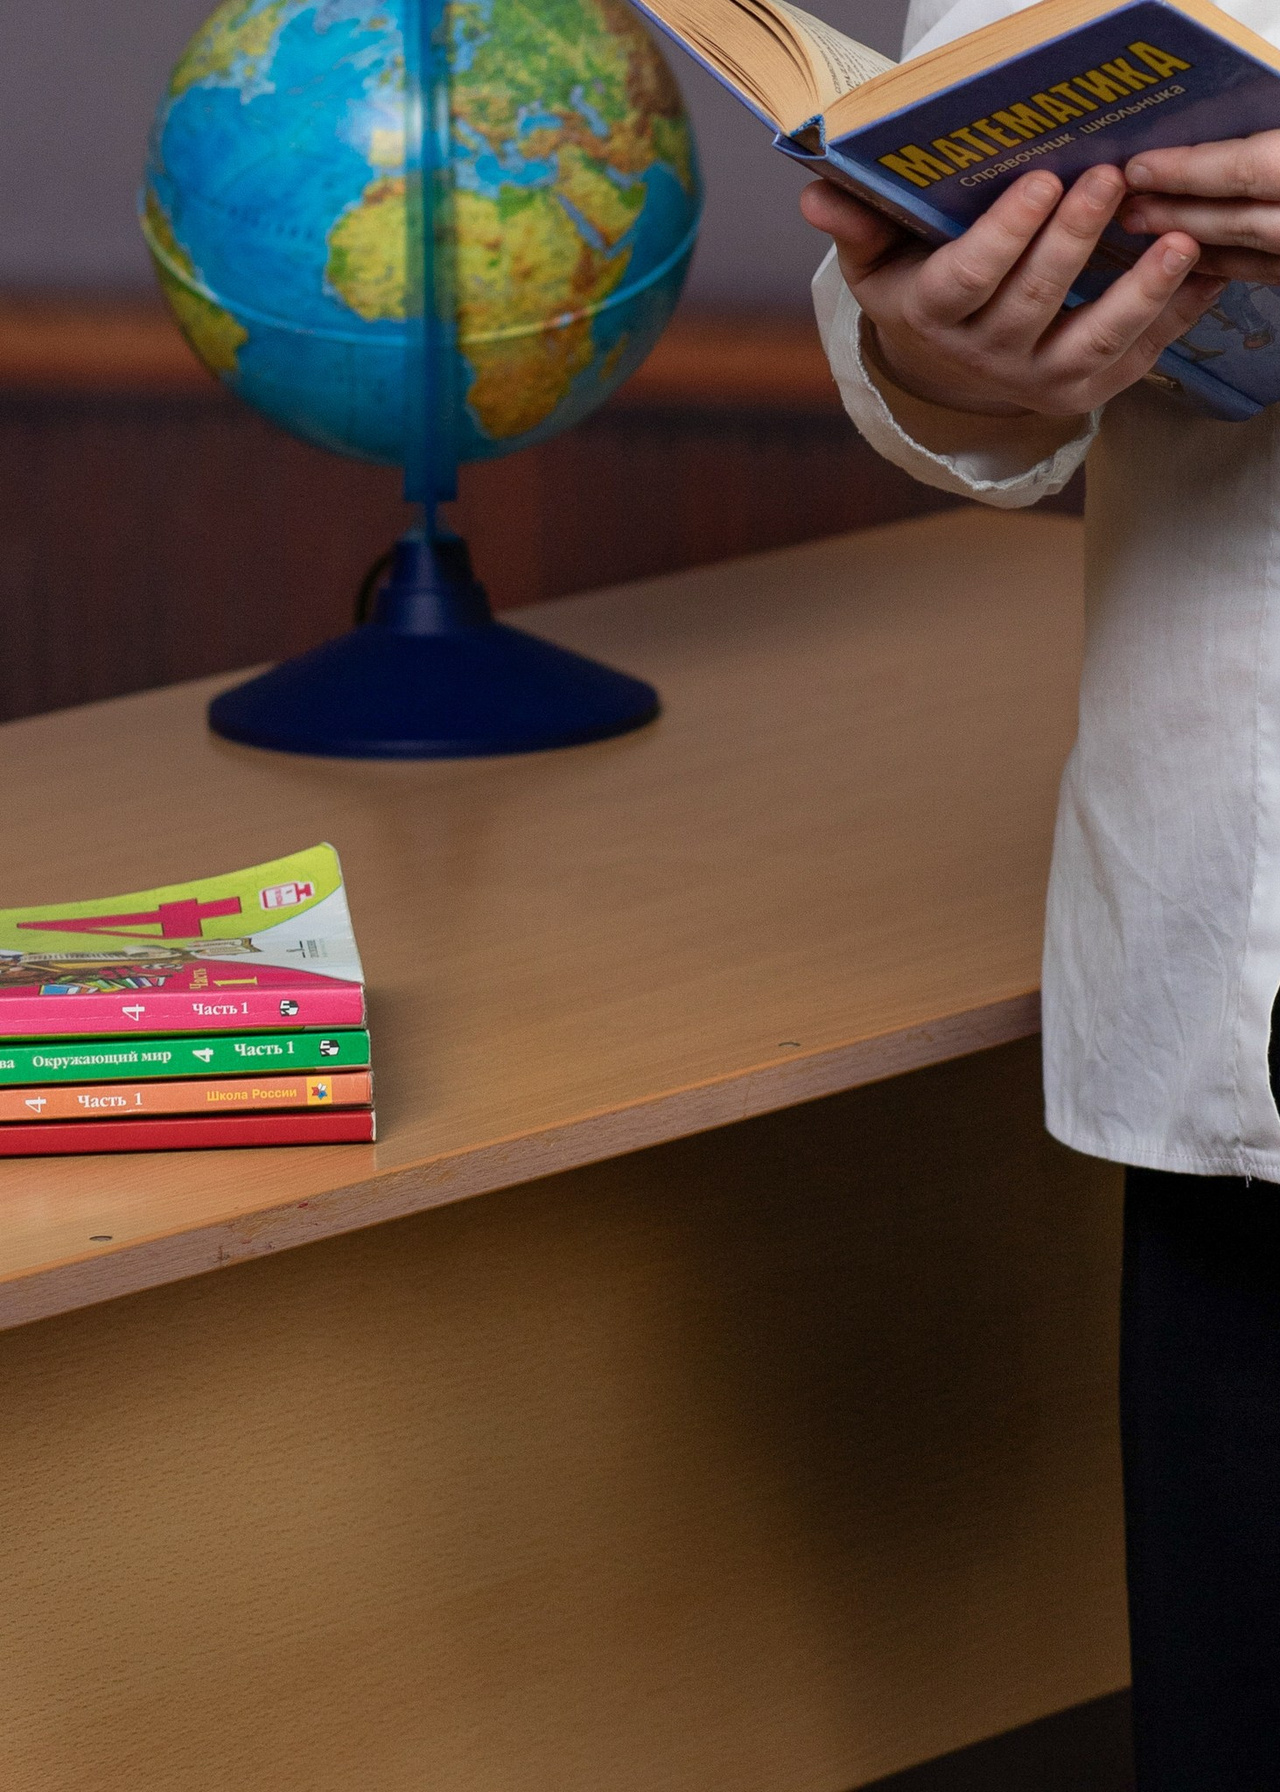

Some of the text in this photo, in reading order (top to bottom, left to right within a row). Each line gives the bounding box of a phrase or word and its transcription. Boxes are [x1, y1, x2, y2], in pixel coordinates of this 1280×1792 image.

[878, 40, 1193, 189] МАТЕМАТИКА
[959, 83, 1186, 188] Справочник школьника
[16, 896, 242, 940] 4
[213, 976, 258, 987] 1
[122, 1001, 249, 1022] 4 Часть 1
[32, 1051, 138, 1070] Окружающий
[141, 1051, 172, 1064] мир
[192, 1048, 214, 1063] 4
[234, 1043, 283, 1057] Часть
[287, 1040, 295, 1054] 1
[25, 1092, 143, 1114] 4 Часть 1
[207, 1087, 298, 1102] Школа России
